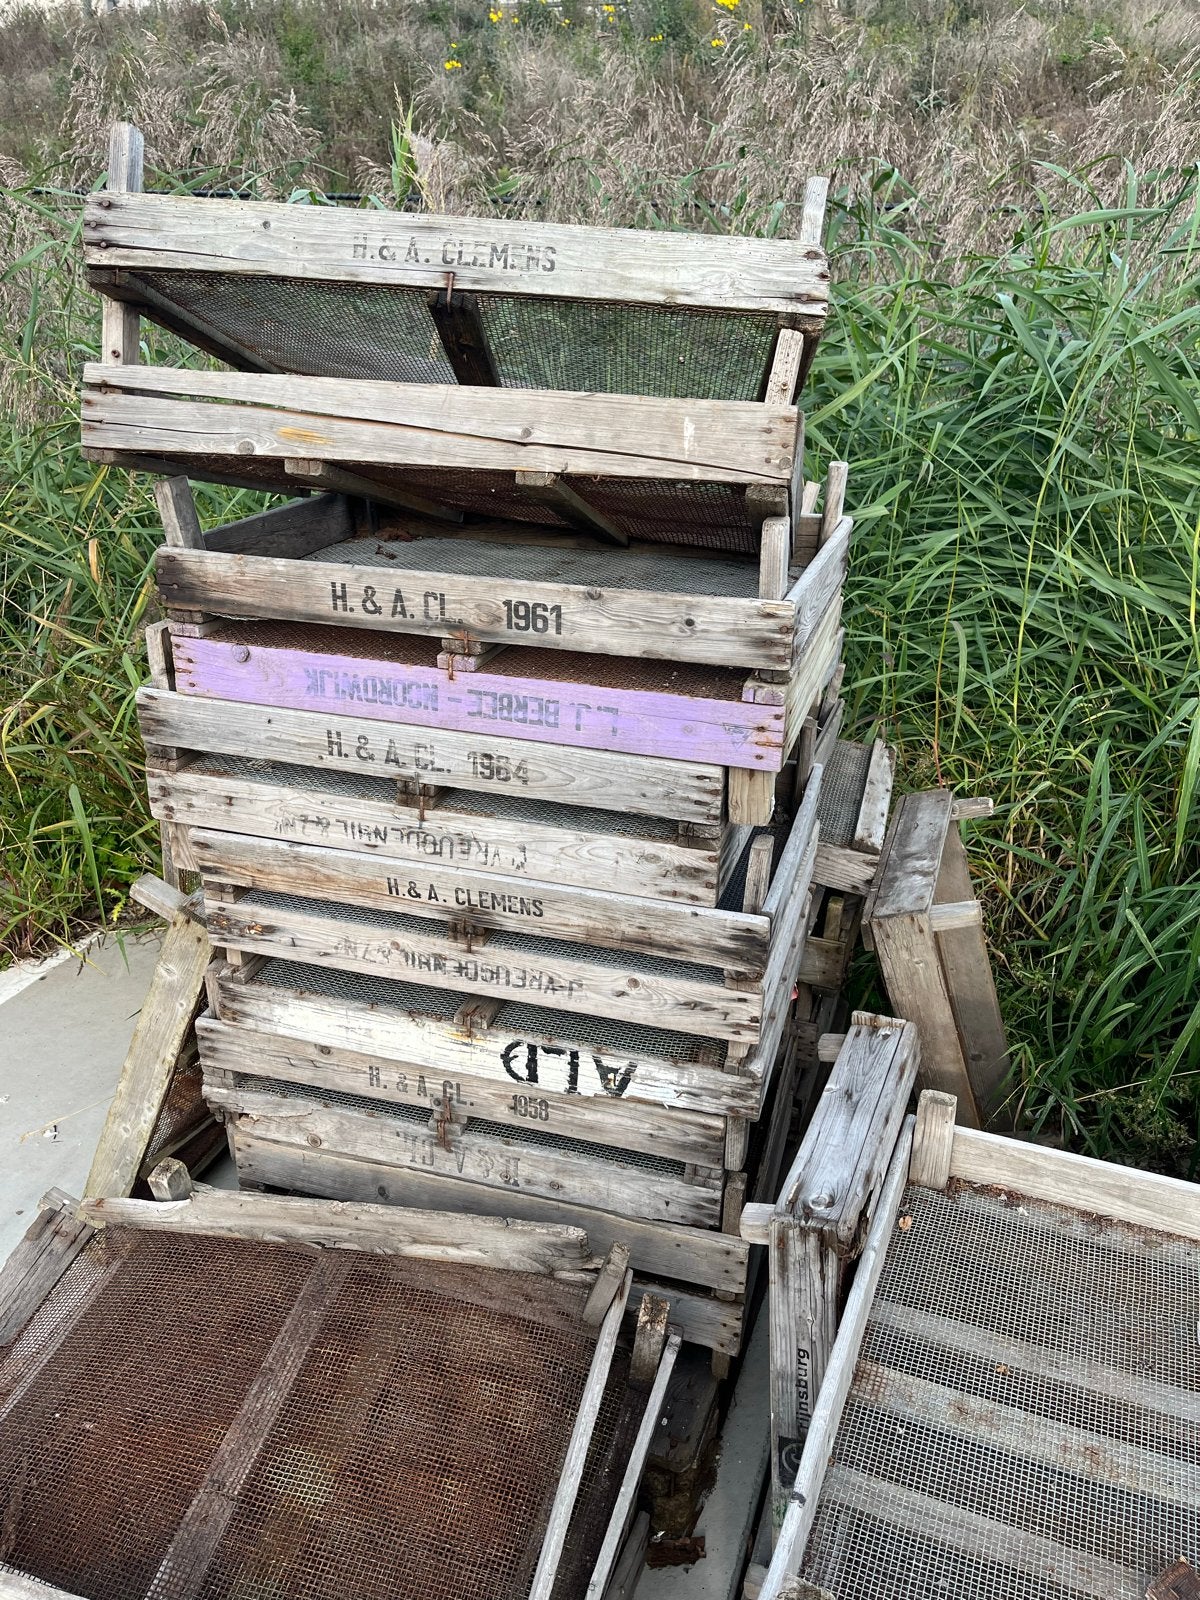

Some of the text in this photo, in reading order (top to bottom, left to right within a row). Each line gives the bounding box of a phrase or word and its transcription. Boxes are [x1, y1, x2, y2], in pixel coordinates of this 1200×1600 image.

[441, 239, 557, 272] CLEMENS
[502, 599, 562, 635] 1961
[304, 667, 438, 711] NOORDWIJK
[467, 688, 559, 728] BERBEE
[467, 751, 529, 785] 1964
[454, 886, 544, 918] CLEMENS
[511, 1093, 550, 1121] 1958
[795, 1348, 810, 1430] rijnsburg
